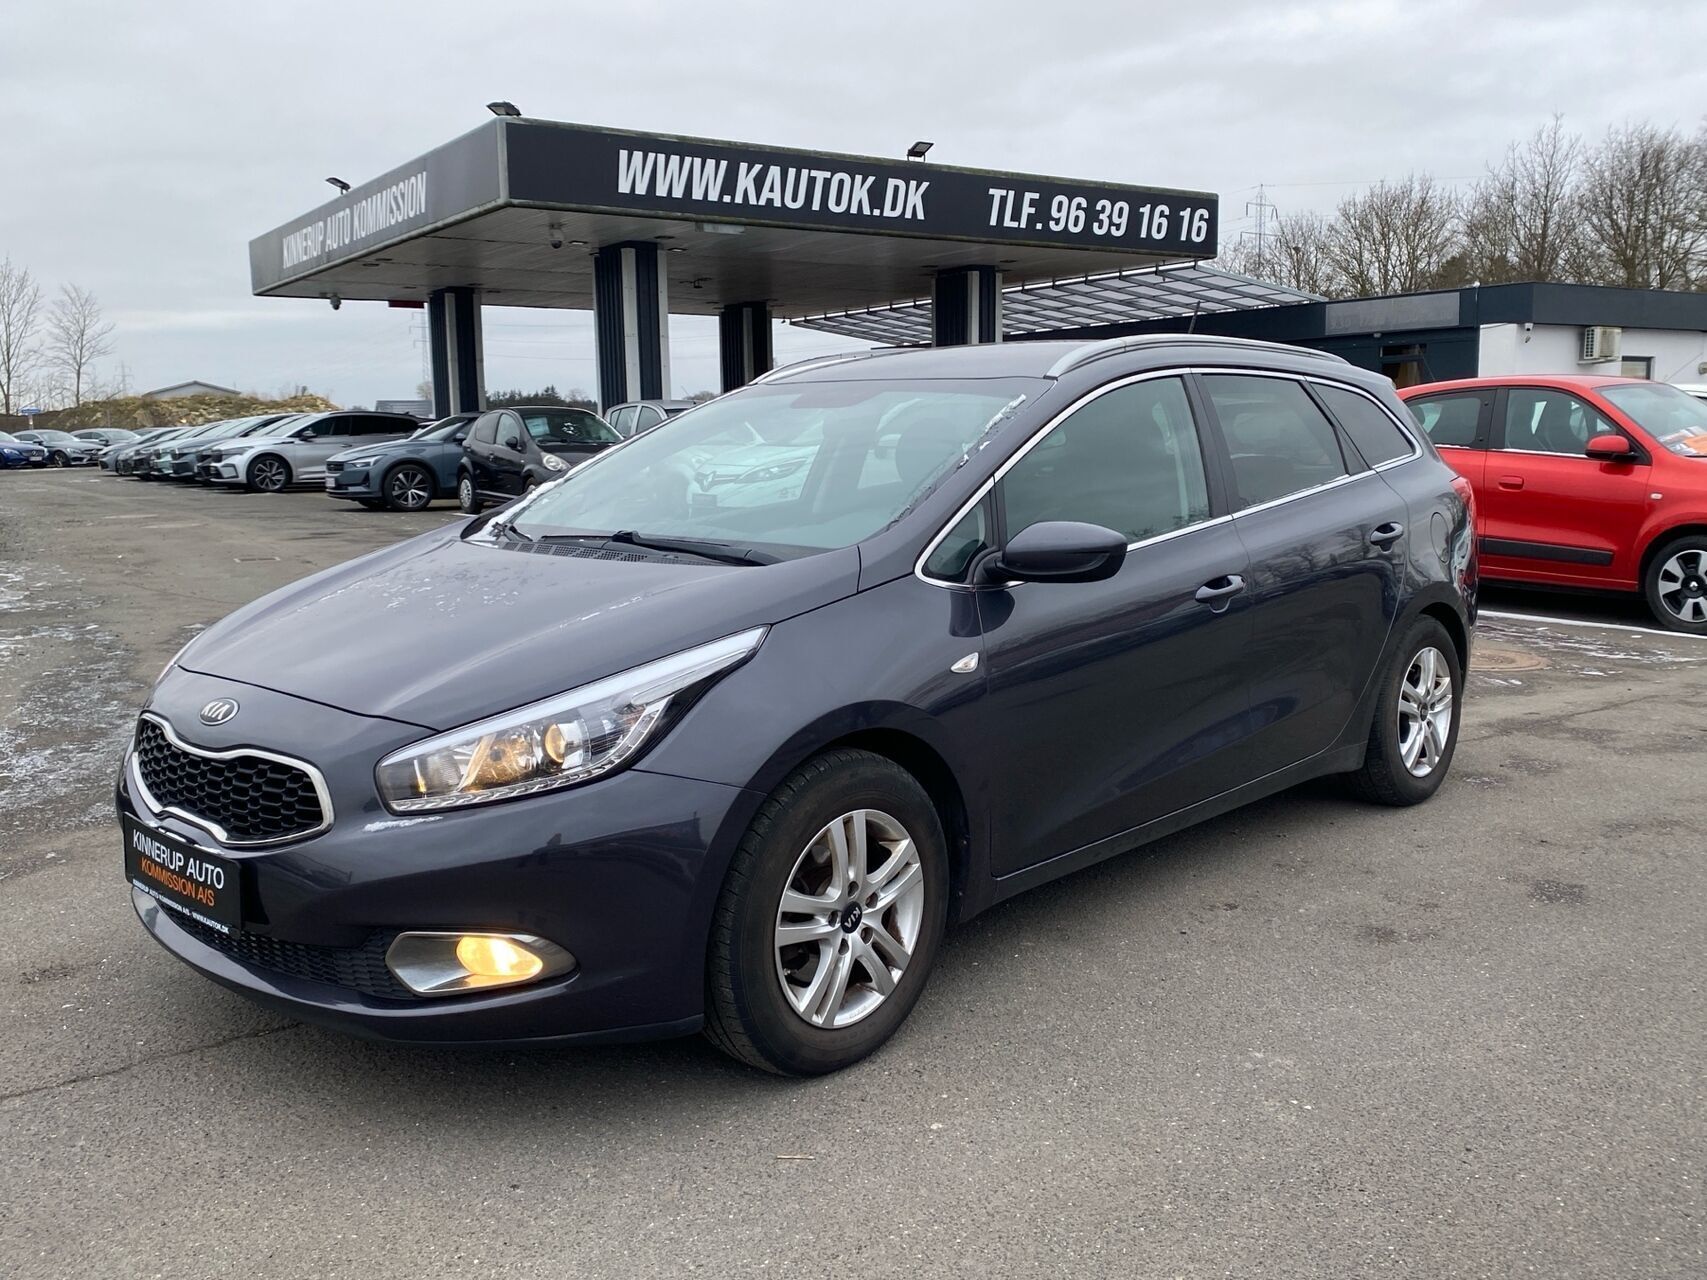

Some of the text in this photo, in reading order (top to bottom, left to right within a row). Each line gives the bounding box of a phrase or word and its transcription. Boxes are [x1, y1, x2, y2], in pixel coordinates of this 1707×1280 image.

[617, 148, 930, 220] WWW.KAUTOK.DK
[282, 171, 427, 269] KINNERUP AUTO KOMMISSION
[988, 188, 1209, 243] TLF. 96 39 16 16
[201, 701, 230, 720] KIA
[133, 829, 225, 890] KINNERUP AUTO
[141, 856, 216, 907] KOMMISSION A/S
[844, 907, 861, 928] KIA
